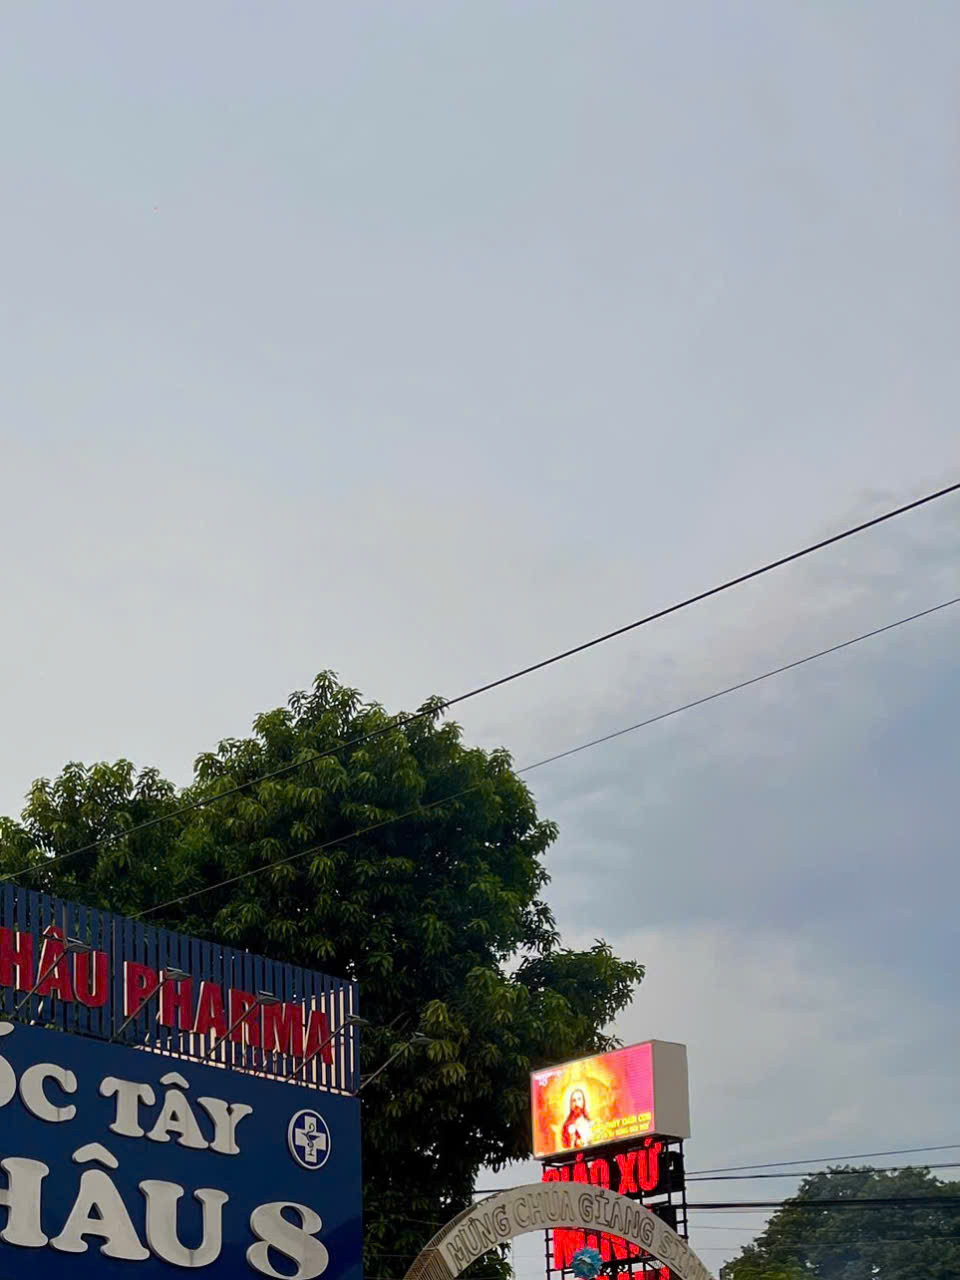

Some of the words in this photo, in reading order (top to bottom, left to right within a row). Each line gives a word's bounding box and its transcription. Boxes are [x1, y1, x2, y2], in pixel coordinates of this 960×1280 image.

[123, 961, 334, 1066] PHARMA
[99, 1070, 253, 1156] TÂY
[615, 1137, 663, 1195] XỨ
[245, 1201, 330, 1280] 8
